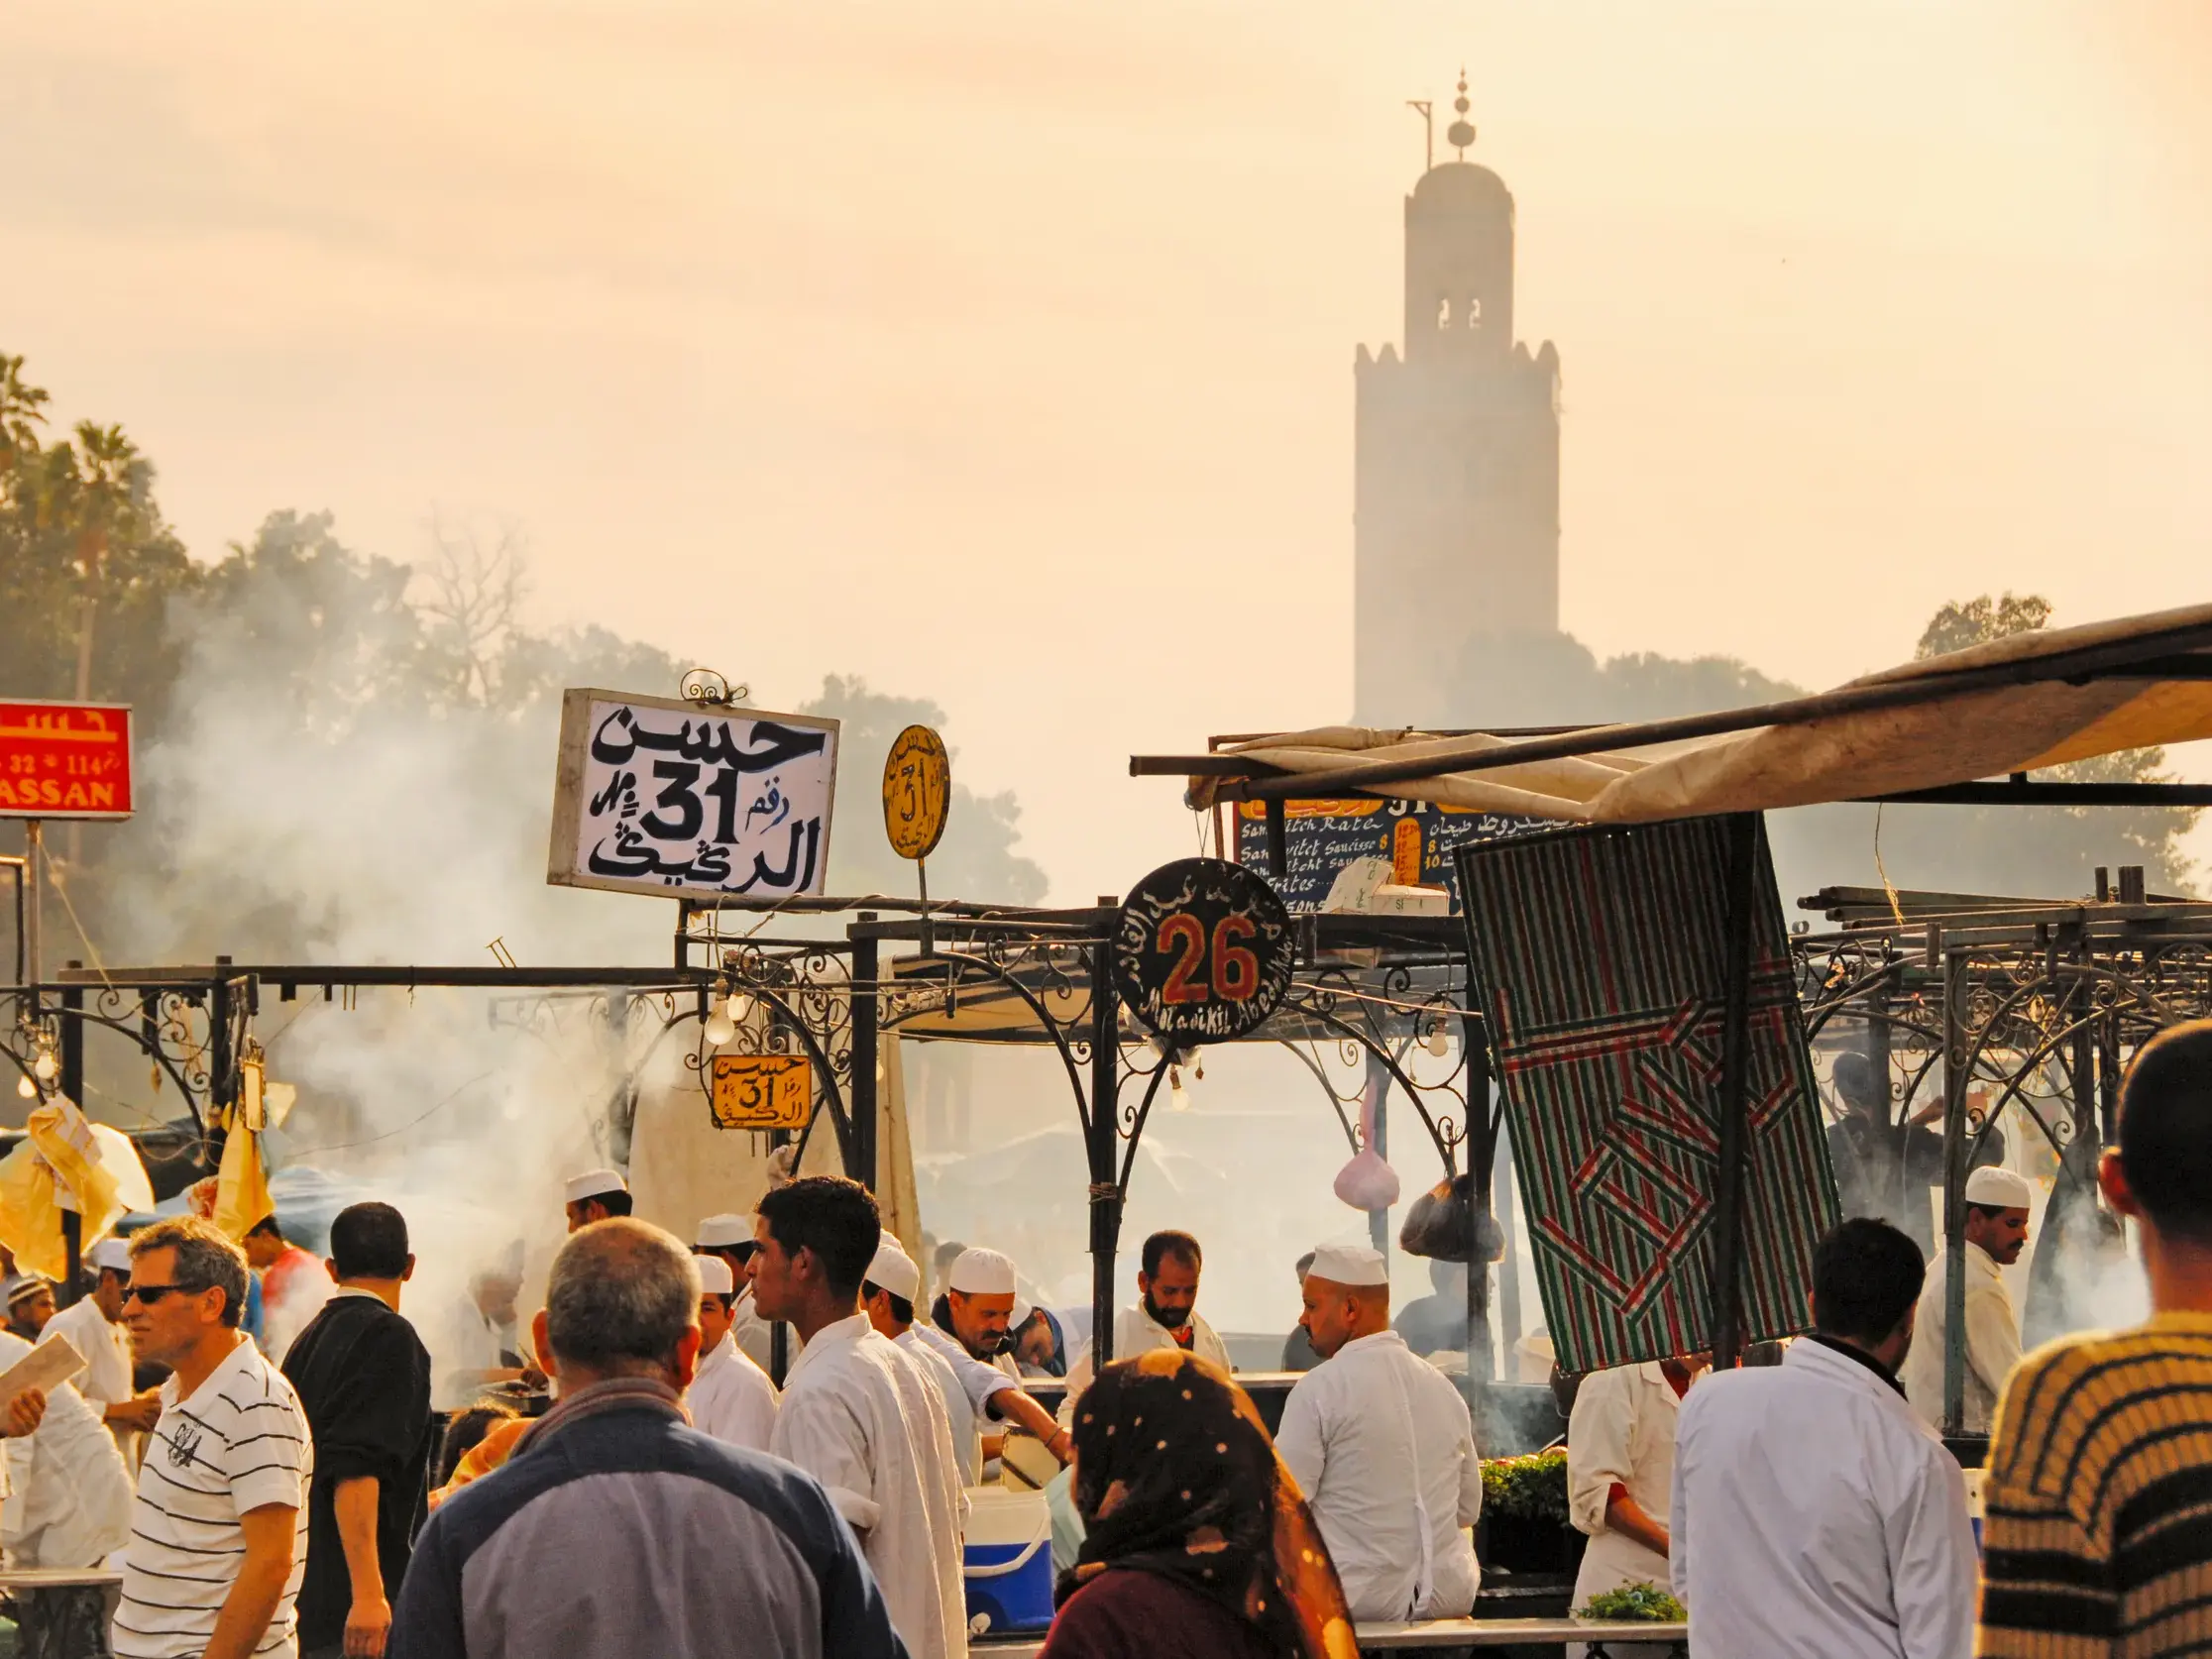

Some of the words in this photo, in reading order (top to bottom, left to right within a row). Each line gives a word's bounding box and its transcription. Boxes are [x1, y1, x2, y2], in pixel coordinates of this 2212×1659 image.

[592, 706, 826, 773] حسن
[0, 778, 115, 807] ASSAN
[639, 759, 740, 844] 31
[745, 776, 789, 834] رقم
[900, 758, 927, 822] 31
[1425, 854, 1441, 870] 10
[1427, 838, 1437, 853] 8
[1156, 912, 1260, 1005] 26
[738, 1076, 774, 1109] 31
